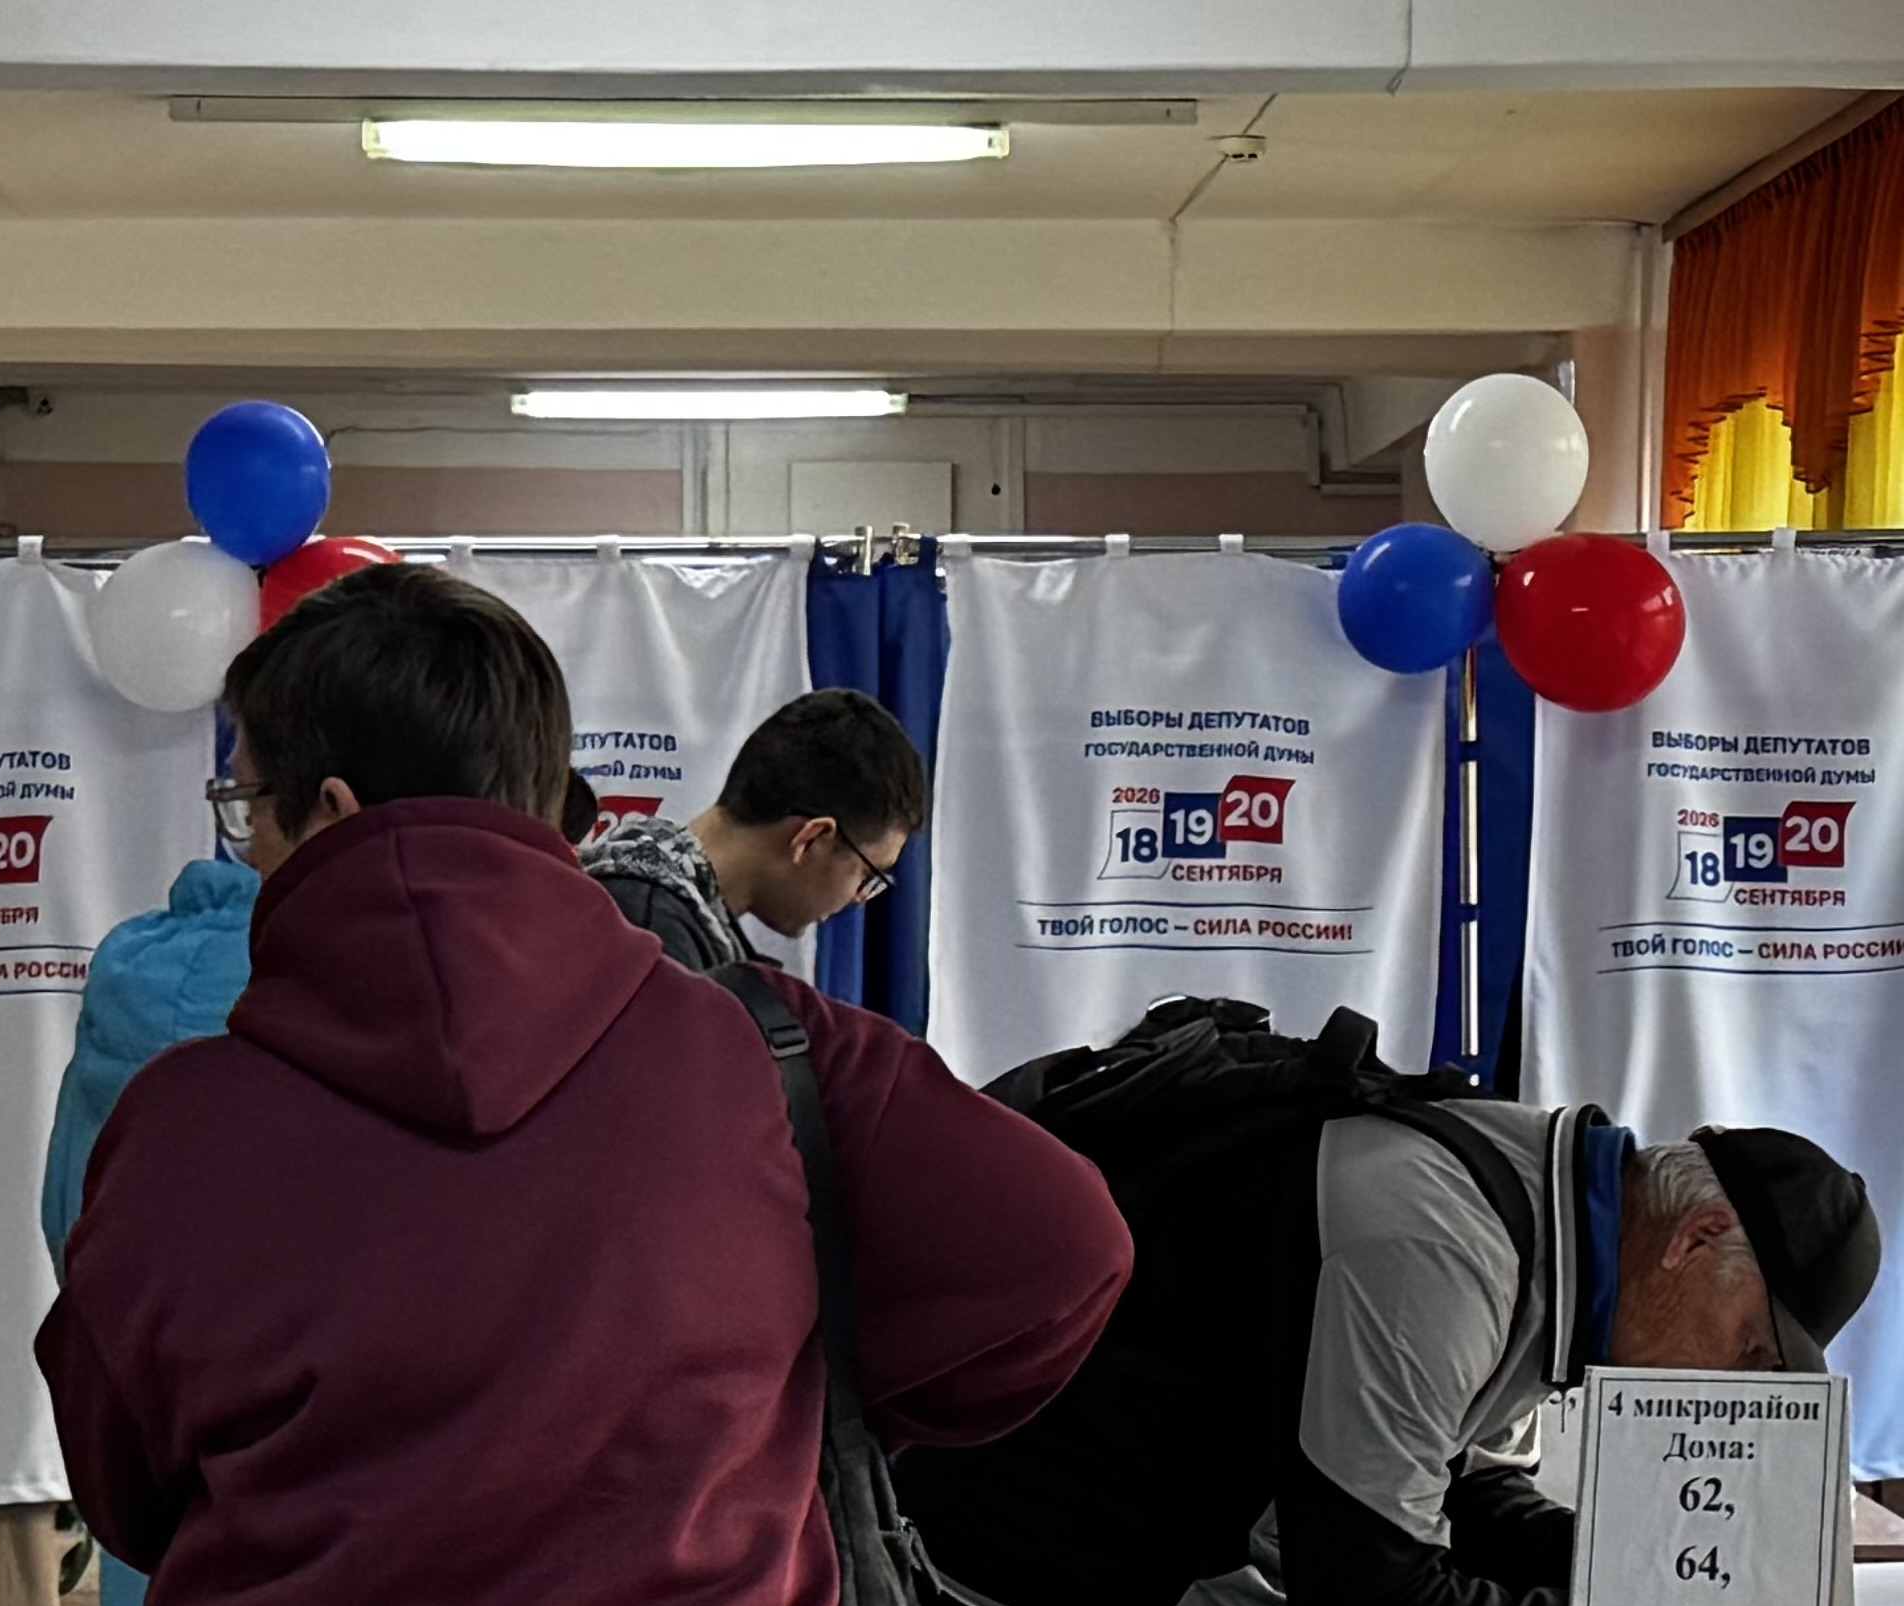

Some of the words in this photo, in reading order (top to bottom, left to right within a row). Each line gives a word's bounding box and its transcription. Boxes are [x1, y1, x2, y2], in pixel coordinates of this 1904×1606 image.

[1091, 709, 1183, 728] ВЫБОРЫ
[1188, 711, 1310, 736] ДЕПУТАТОВ
[1085, 740, 1259, 758] ГОСУДАРСТВЕННОЙ
[1263, 745, 1315, 764] ДУМЫ
[1652, 731, 1739, 753] ВЫБОРЫ
[1744, 736, 1871, 756] ДЕПУТАТОВ
[1647, 763, 1815, 784] ГОСУДАРСТВЕННОЙ
[1820, 769, 1875, 785] ДУМЫ
[19, 783, 75, 800] ДУМЫ
[1112, 787, 1161, 804] 2026
[1116, 827, 1159, 863] 18
[1170, 809, 1214, 845] 19
[1224, 791, 1279, 828] 20
[1677, 809, 1720, 828] 2026
[1685, 851, 1720, 887] 18
[1730, 833, 1774, 869] 19
[1785, 815, 1839, 852] 20
[1172, 864, 1283, 884] СЕНТЯБРЯ
[1734, 889, 1846, 907] СЕНТЯБРЯ
[1038, 915, 1094, 936] ТВОЙ
[1100, 918, 1169, 935] ГОЛОС
[1194, 919, 1251, 936] СИЛА
[1258, 920, 1352, 940] РОССИИ!
[1611, 932, 1665, 958] ТВОЙ
[1671, 938, 1734, 958] ГОЛОС
[1758, 942, 1817, 960] СИЛА
[14, 961, 88, 980] РОССИ
[1607, 1391, 1623, 1417] 4
[1633, 1395, 1820, 1425] микрорайон
[1662, 1432, 1756, 1463] Дома:
[1678, 1476, 1735, 1521] 62,
[1675, 1545, 1731, 1589] 64,
